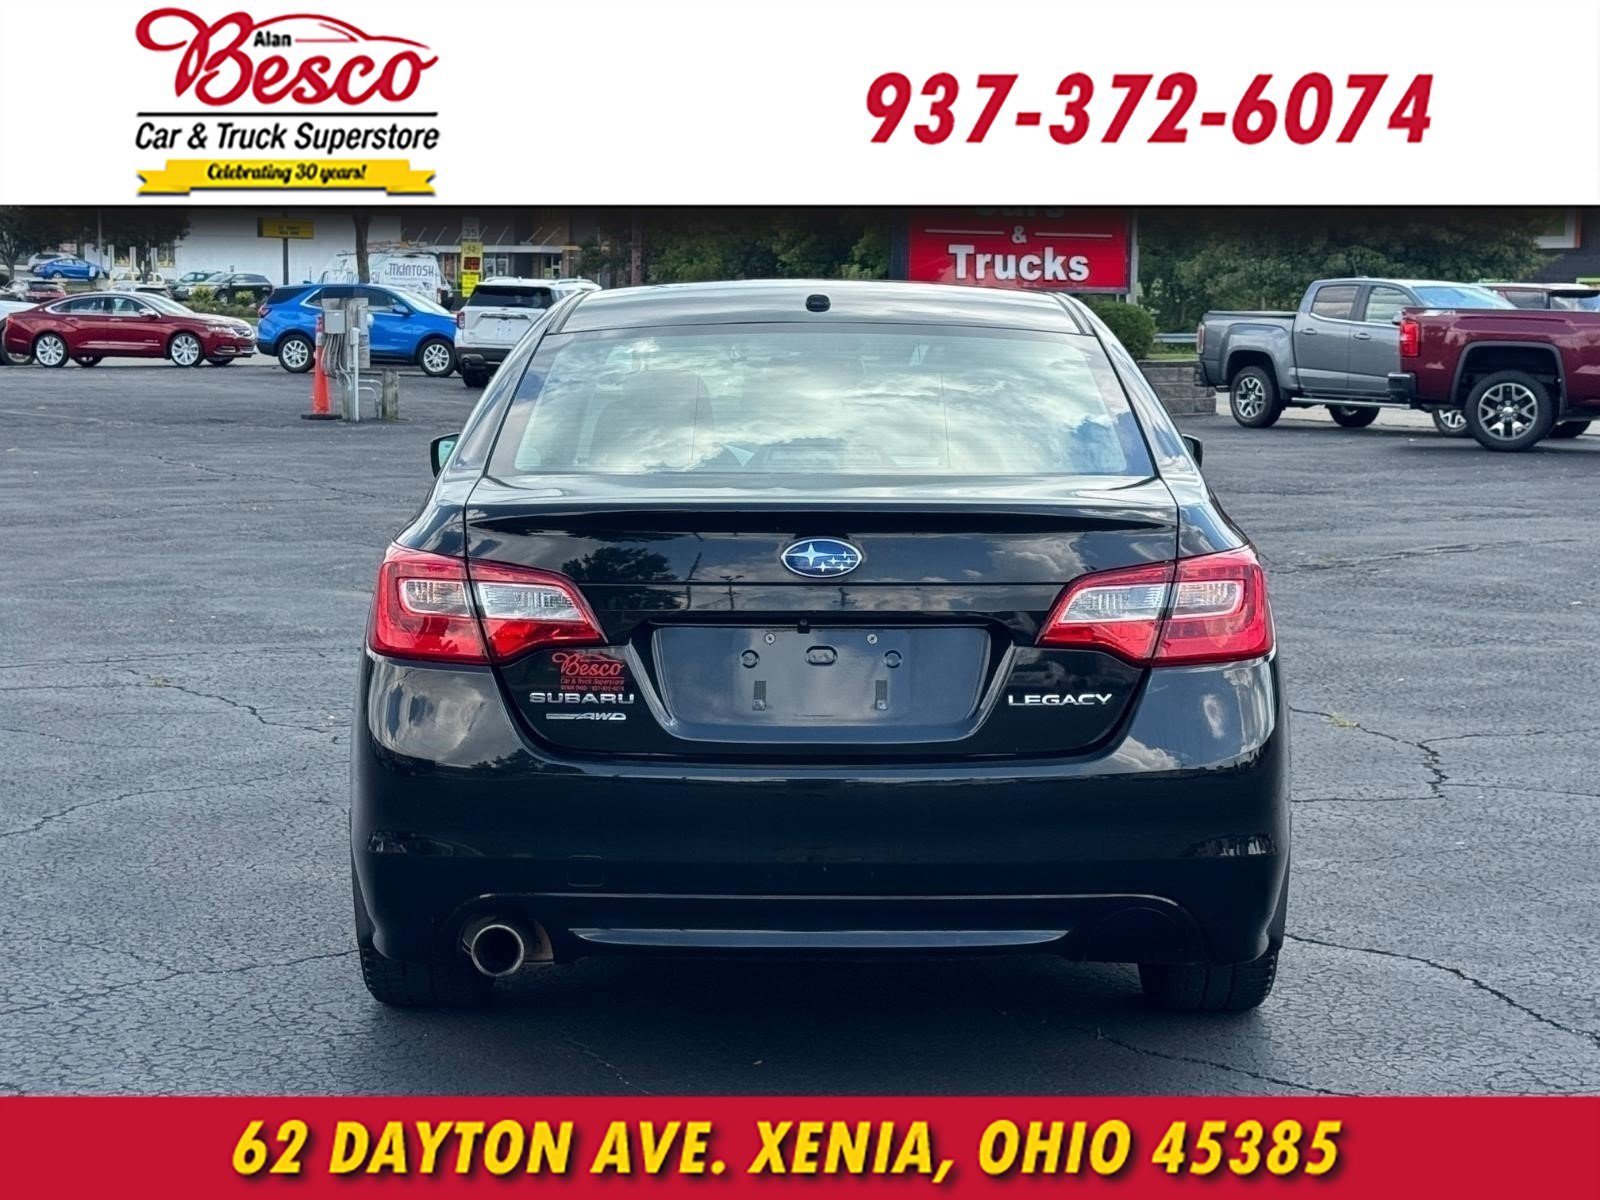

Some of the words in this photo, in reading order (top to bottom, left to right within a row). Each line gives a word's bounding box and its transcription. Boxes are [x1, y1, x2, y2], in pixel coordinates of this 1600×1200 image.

[1012, 225, 1027, 244] &
[948, 244, 1090, 282] Trucks
[552, 652, 625, 676] Besco
[529, 692, 635, 705] SUBARU
[1008, 693, 1113, 706] LEGACY
[576, 712, 627, 721] AWD
